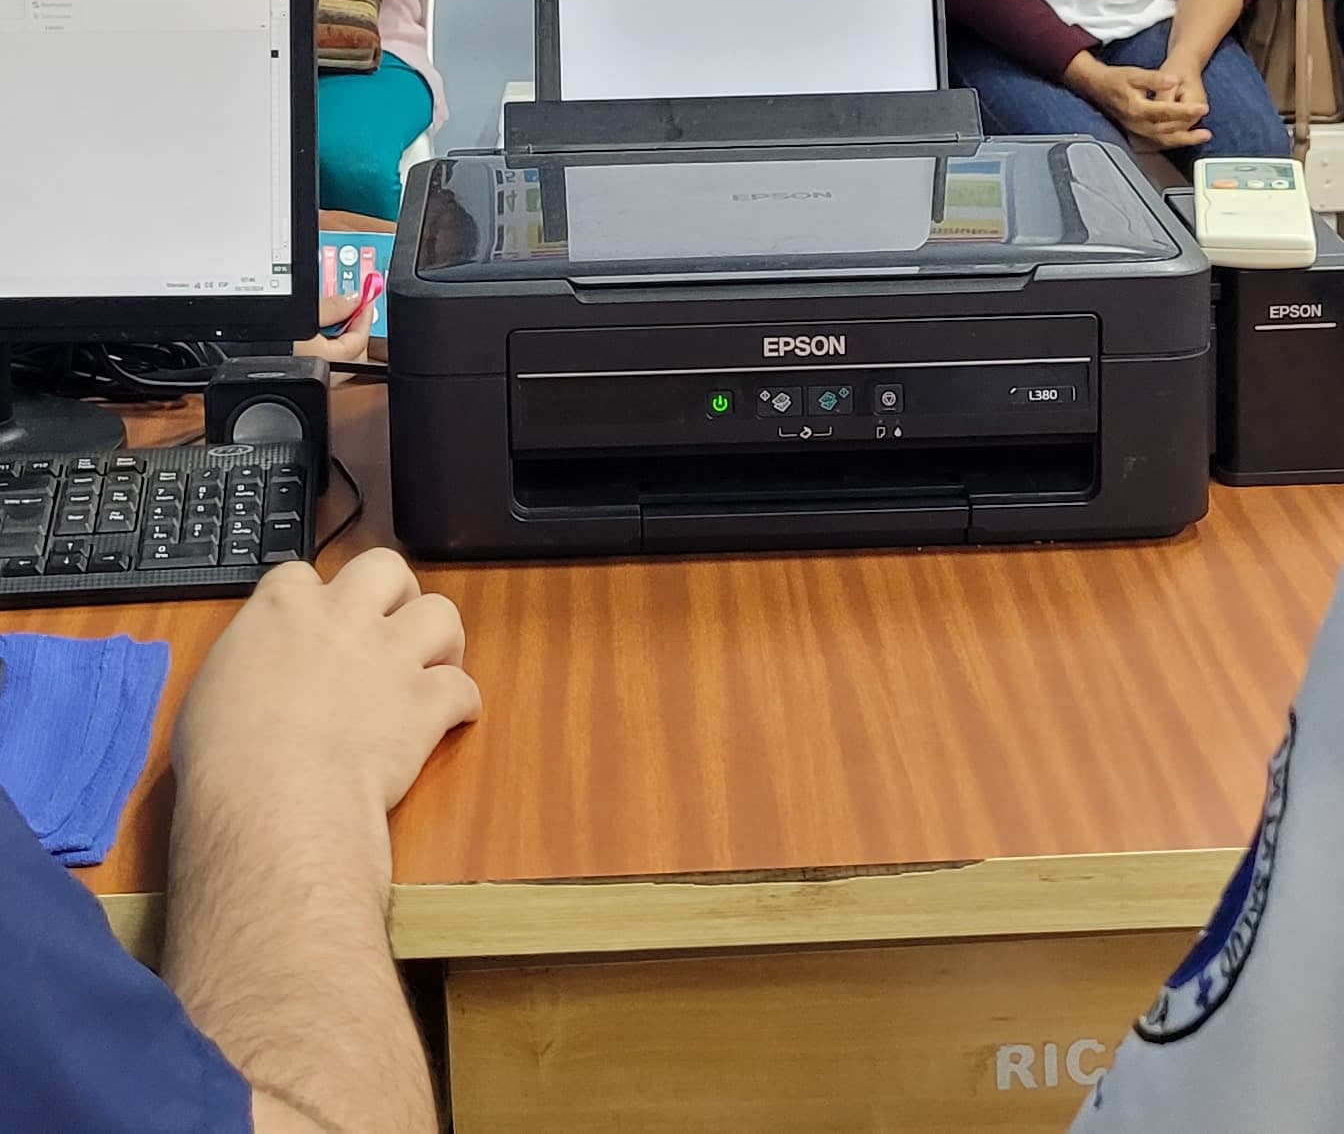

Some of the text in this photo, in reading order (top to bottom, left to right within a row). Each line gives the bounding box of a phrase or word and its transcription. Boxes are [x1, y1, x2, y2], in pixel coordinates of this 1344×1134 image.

[731, 190, 832, 203] EPSON
[1269, 304, 1322, 318] EPSON
[763, 335, 846, 357] EPSON
[1028, 389, 1058, 401] L380
